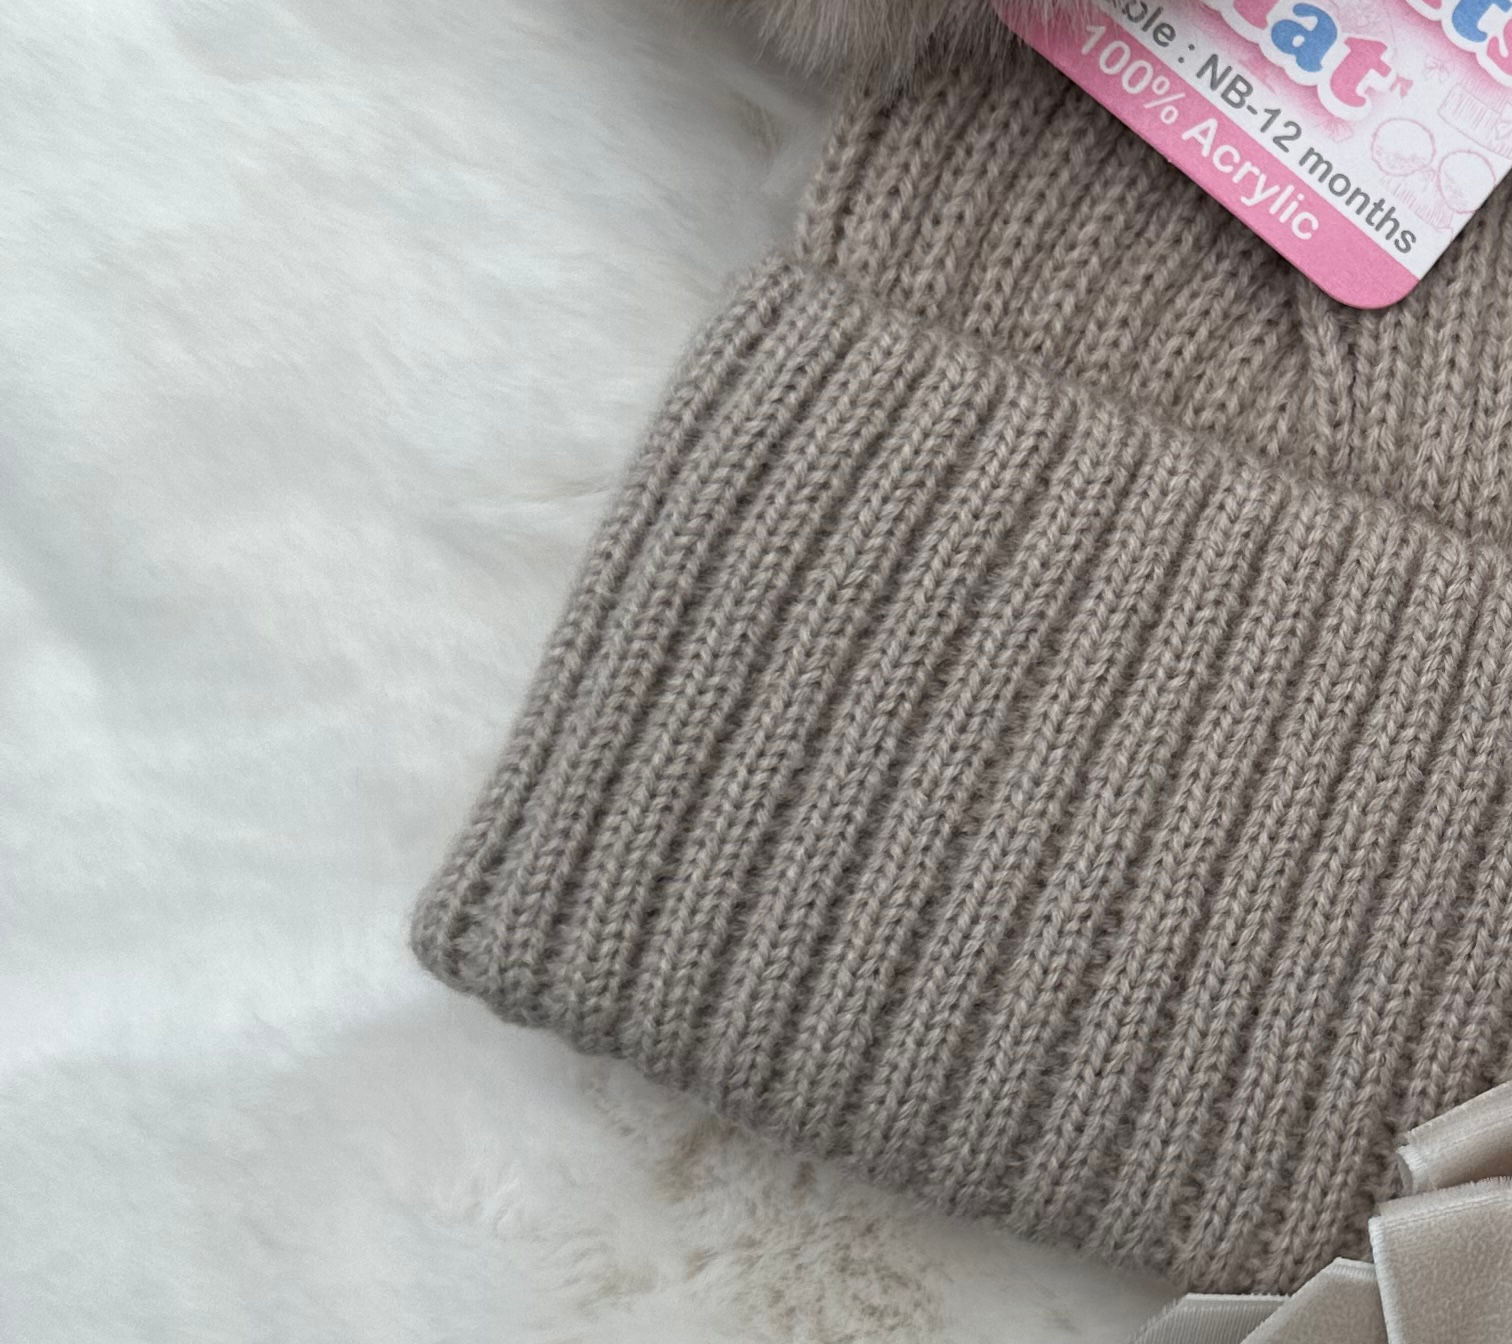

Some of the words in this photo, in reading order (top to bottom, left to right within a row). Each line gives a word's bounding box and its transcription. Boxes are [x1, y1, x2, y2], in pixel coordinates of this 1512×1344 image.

[1081, 24, 1187, 126] 100%
[1181, 117, 1320, 241] Acrylic
[1196, 53, 1303, 154] NB-12
[1299, 146, 1417, 255] months
